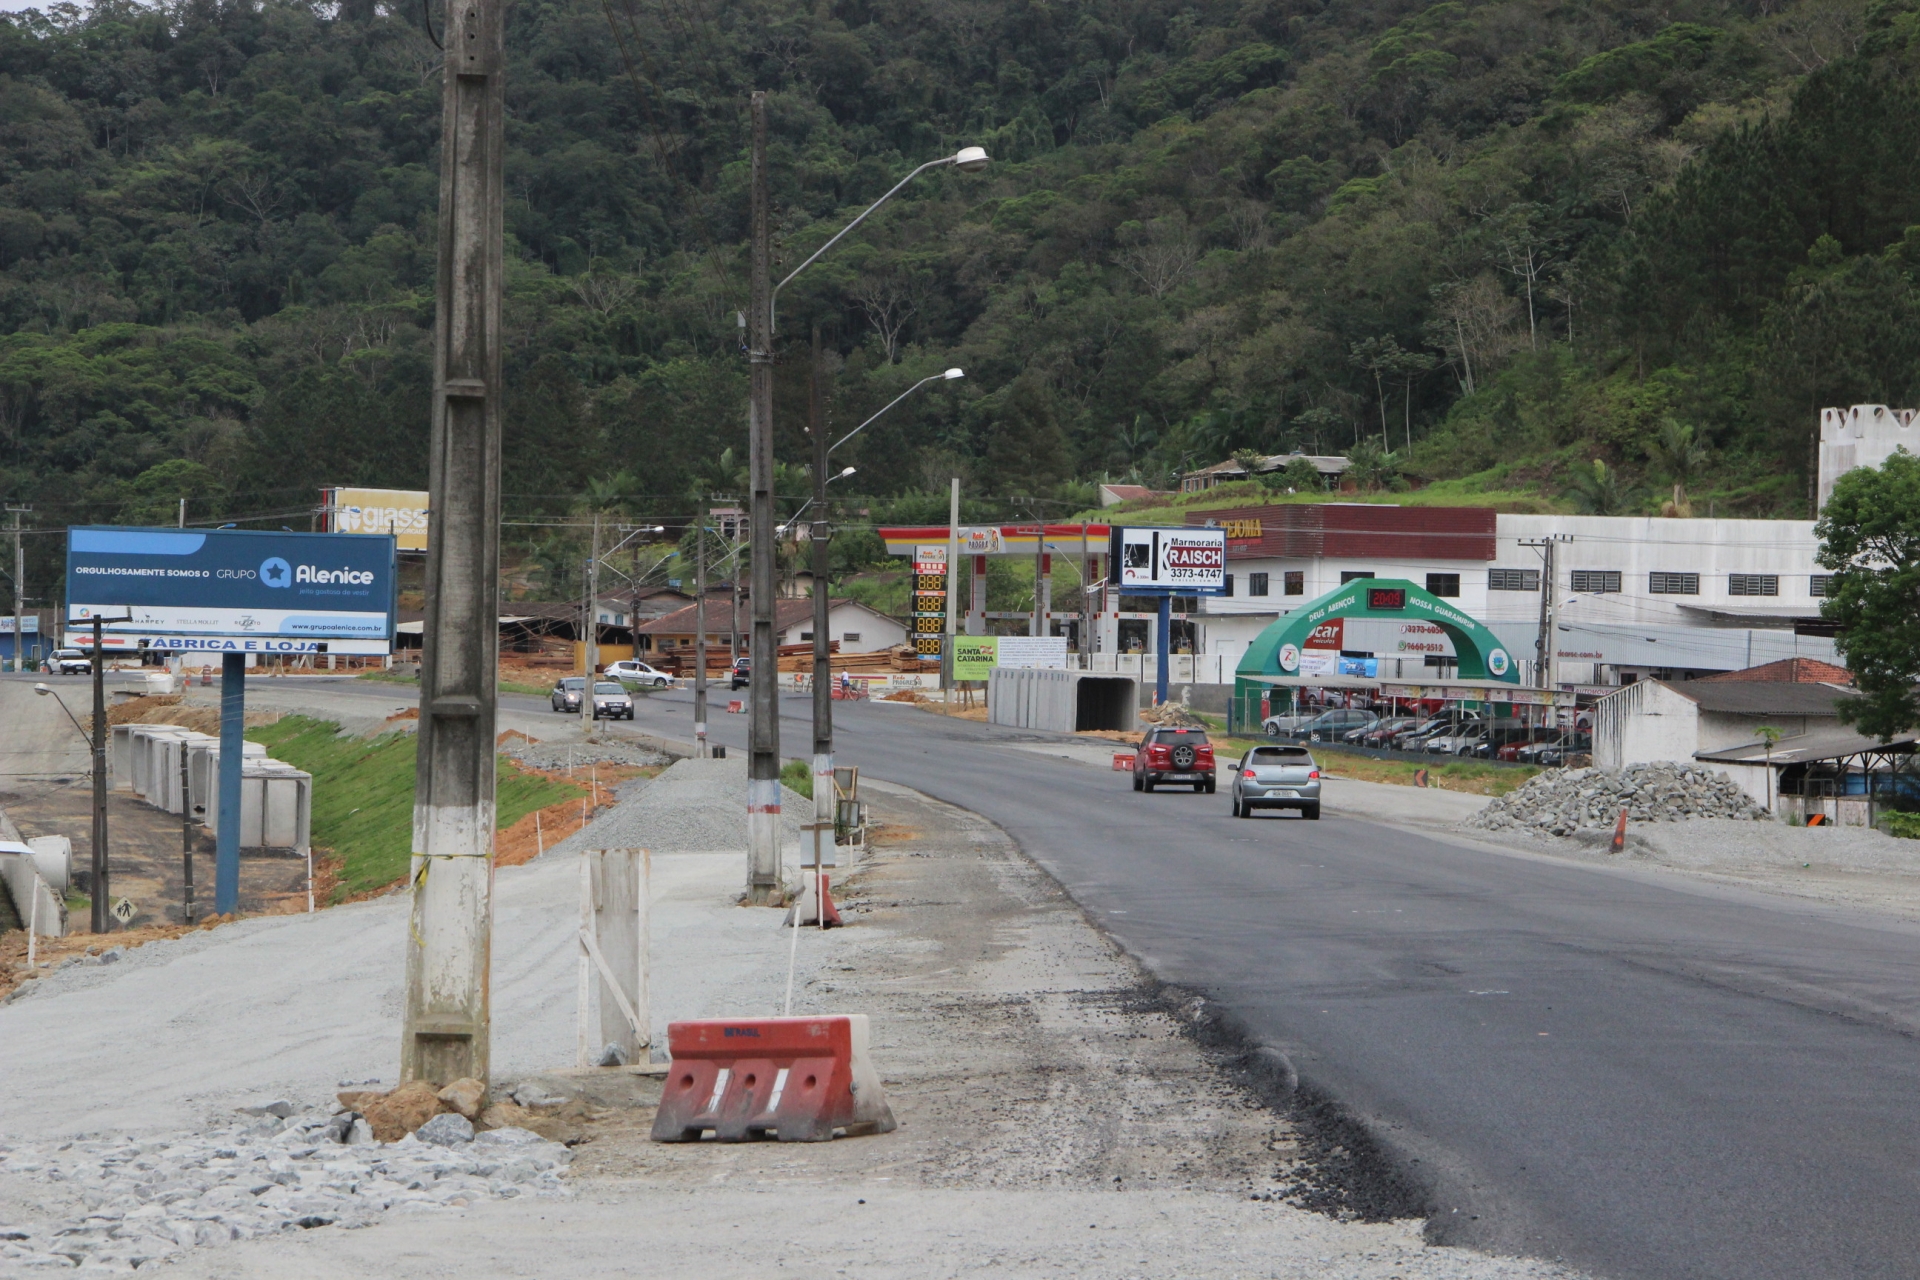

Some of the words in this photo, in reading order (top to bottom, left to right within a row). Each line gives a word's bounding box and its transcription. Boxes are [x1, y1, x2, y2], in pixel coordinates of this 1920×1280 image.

[379, 527, 428, 535] SUPRMERCADO
[1171, 538, 1222, 547] Marmoraria
[1163, 543, 1221, 570] KRAISCH
[75, 566, 165, 577] ORGULHOSAMENTE
[167, 569, 200, 577] SOMOS
[202, 570, 210, 578] O
[216, 569, 256, 579] GRUPO
[296, 564, 374, 585] Alenice
[1170, 568, 1222, 579] 3373-4747
[1309, 609, 1325, 622] DEUS
[1328, 595, 1356, 613] ABENÇOE
[1409, 596, 1432, 611] NOSSA
[1434, 605, 1475, 630] GUARAMIRIM
[292, 623, 382, 632] www.grupoalenice.com.br
[1306, 625, 1340, 639] car
[139, 637, 237, 650] ÁBRICA
[244, 641, 258, 650] E
[265, 641, 320, 651] LOJA
[1407, 642, 1444, 652] 9660-2512
